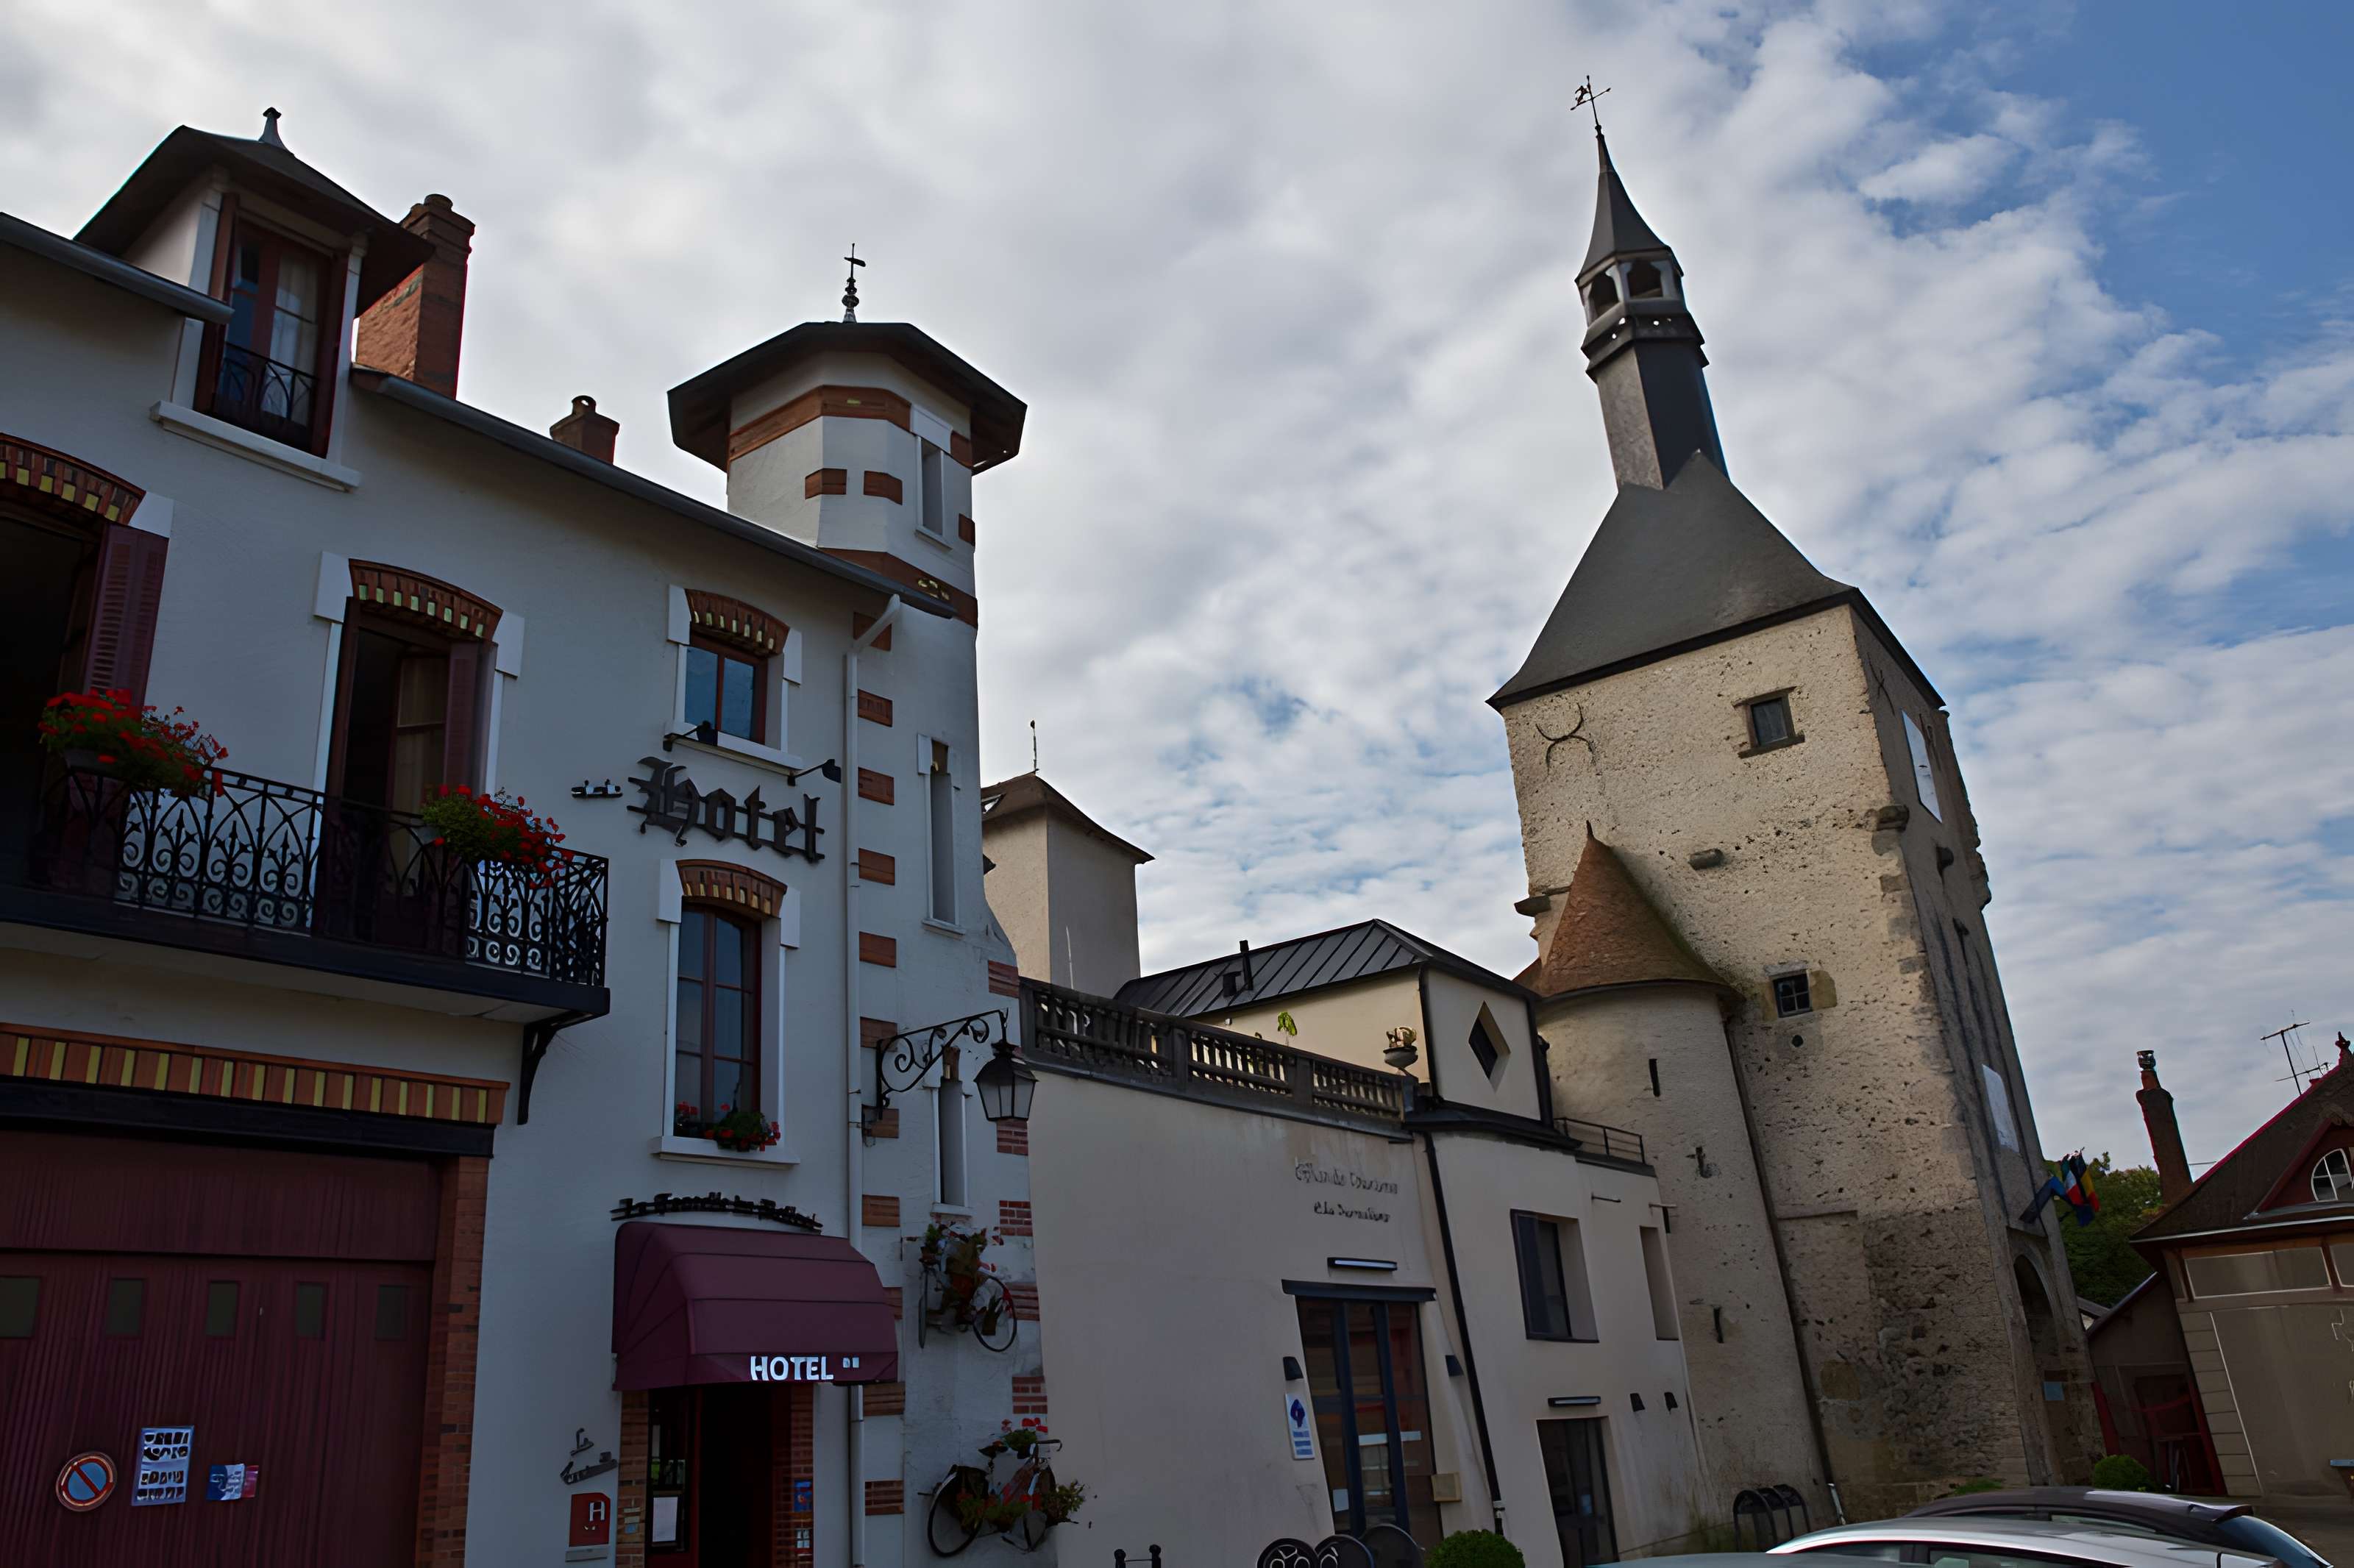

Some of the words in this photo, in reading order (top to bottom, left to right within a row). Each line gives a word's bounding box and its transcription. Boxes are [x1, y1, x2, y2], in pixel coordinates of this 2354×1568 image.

[627, 756, 825, 863] Hotel
[750, 1355, 833, 1381] HOTEL
[588, 1500, 606, 1522] H
